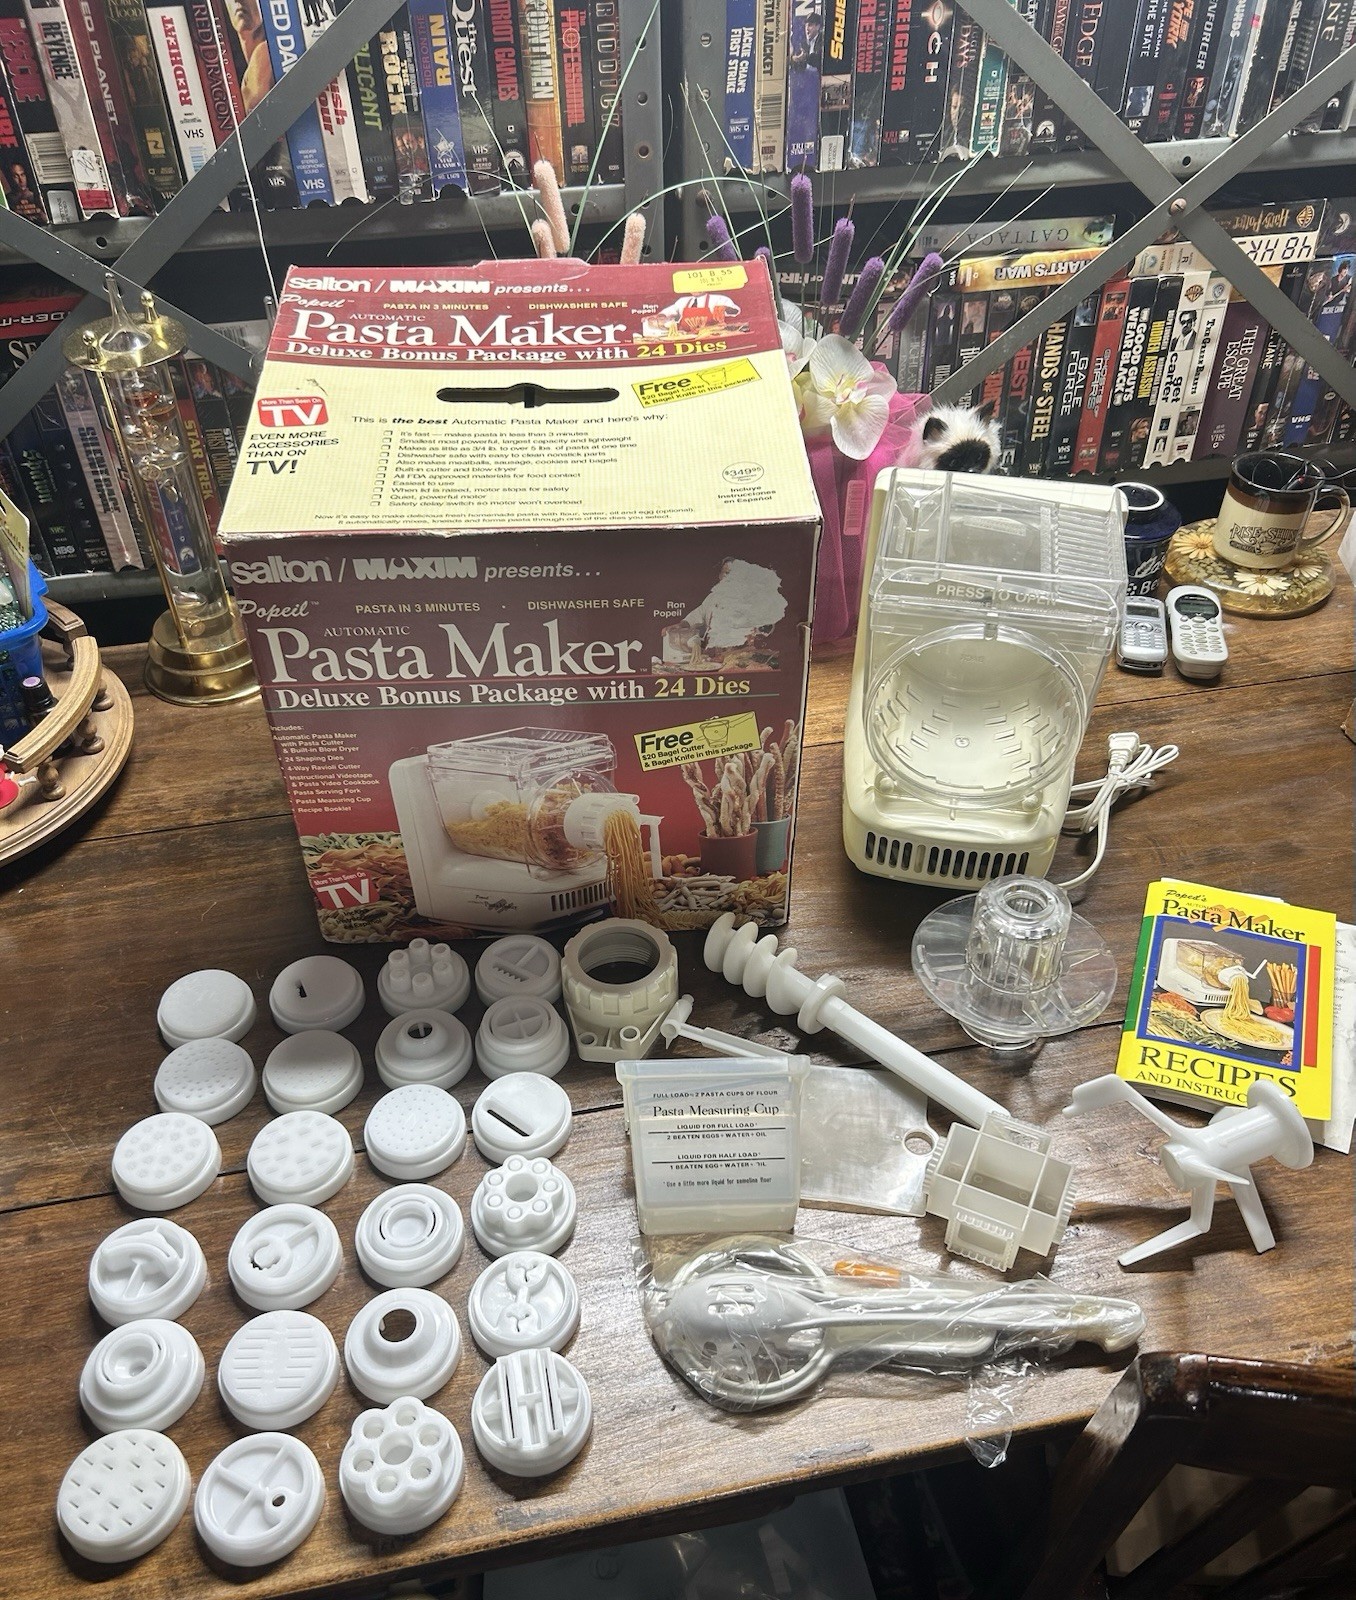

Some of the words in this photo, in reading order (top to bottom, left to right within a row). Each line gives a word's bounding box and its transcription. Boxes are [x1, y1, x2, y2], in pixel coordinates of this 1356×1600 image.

[192, 4, 213, 43] RED
[1075, 2, 1103, 67] EDGE
[428, 14, 452, 87] RAIN
[729, 28, 742, 57] FIRST
[741, 26, 754, 58] JACKIE
[763, 26, 774, 76] JACKET
[891, 0, 912, 91] REIGNER
[1140, 24, 1154, 58] STATE
[379, 30, 408, 115] ROCK
[494, 48, 519, 101] GAMES
[530, 58, 555, 100] MEN
[560, 10, 585, 127] PROFESSIONAL
[595, 2, 620, 128] RIDDICK
[726, 59, 739, 94] STRIKE
[91, 40, 120, 126] PLANET
[201, 44, 235, 131] DRAGON
[184, 129, 205, 140] VHS
[303, 178, 325, 190] VHS
[967, 228, 1069, 246] GATTACA
[1282, 236, 1314, 261] 48
[288, 276, 371, 294] salton
[390, 280, 491, 293] MAXIM
[995, 265, 1031, 280] WAR
[349, 313, 426, 322] AUTOMATIC
[528, 302, 598, 310] DISHWASHER
[288, 308, 437, 346] Pasta
[448, 313, 627, 347] Maker
[1122, 307, 1139, 349] WEAR
[1149, 320, 1165, 353] HIDDEN
[1240, 325, 1259, 359] THE
[286, 341, 372, 359] Deluxe
[381, 347, 458, 361] Bonus
[467, 346, 567, 364] Package
[575, 346, 630, 361] with
[637, 345, 667, 359] 24
[674, 339, 727, 355] Dies
[1041, 322, 1067, 379] HANDS
[1130, 323, 1148, 365] GOOD
[1261, 340, 1277, 370] JANE
[1113, 351, 1131, 394] BLACK
[1138, 356, 1155, 399] ASSASSIN
[1161, 352, 1178, 403] carter
[1217, 340, 1241, 390] ESCAPE
[1228, 357, 1251, 401] GREAT
[639, 377, 692, 396] Free
[1060, 350, 1080, 416] FORCE
[1072, 356, 1089, 408] GALE
[1123, 366, 1138, 402] GUYS
[1171, 376, 1183, 403] get
[261, 404, 323, 427] TV
[352, 416, 375, 424] This
[418, 417, 448, 425] best
[607, 415, 639, 423] here's
[1031, 395, 1055, 442] STEEL
[1291, 414, 1312, 424] VHS
[248, 438, 339, 449] ACCESSORIES
[288, 431, 327, 439] MORE
[184, 419, 204, 459] STAR
[196, 463, 214, 500] TREK
[246, 450, 284, 458] THAN
[287, 449, 307, 457] ON
[246, 459, 298, 475] TV!
[1266, 526, 1299, 545] SHIN
[231, 555, 333, 584] salton
[352, 556, 478, 581] MAXIM
[484, 562, 601, 582] presents...
[527, 599, 609, 611] DISHWASHER
[612, 598, 645, 609] SAFE
[667, 601, 686, 609] Ron
[936, 584, 985, 599] PRESS
[355, 604, 395, 614] PASTA
[399, 604, 412, 613] IN
[414, 603, 422, 613] 3
[425, 602, 481, 612] MINUTES
[653, 609, 682, 618] Popeil
[324, 625, 411, 638] AUTOMATIC
[257, 627, 434, 683] Pasta
[438, 618, 643, 679] Maker
[275, 688, 370, 709] Deluxe
[377, 685, 461, 706] Bonus
[469, 682, 578, 707] Package
[587, 679, 645, 701] with
[655, 677, 686, 698] 24
[695, 675, 751, 696] Dies
[640, 728, 694, 754] Free
[642, 753, 656, 761] $20
[658, 748, 680, 760] Bagel
[681, 743, 705, 754] Cutter
[652, 757, 674, 768] Bagel
[674, 752, 696, 764] Knife
[705, 747, 720, 757] this
[721, 742, 753, 755] package
[317, 878, 370, 909] TV
[1161, 898, 1223, 928] Pasta
[1229, 911, 1306, 942] Maker
[1135, 1069, 1172, 1085] AND
[1176, 1078, 1249, 1104] INSTRUC
[653, 1105, 684, 1118] Pasta
[689, 1103, 750, 1117] Measuring
[754, 1103, 780, 1116] Cup
